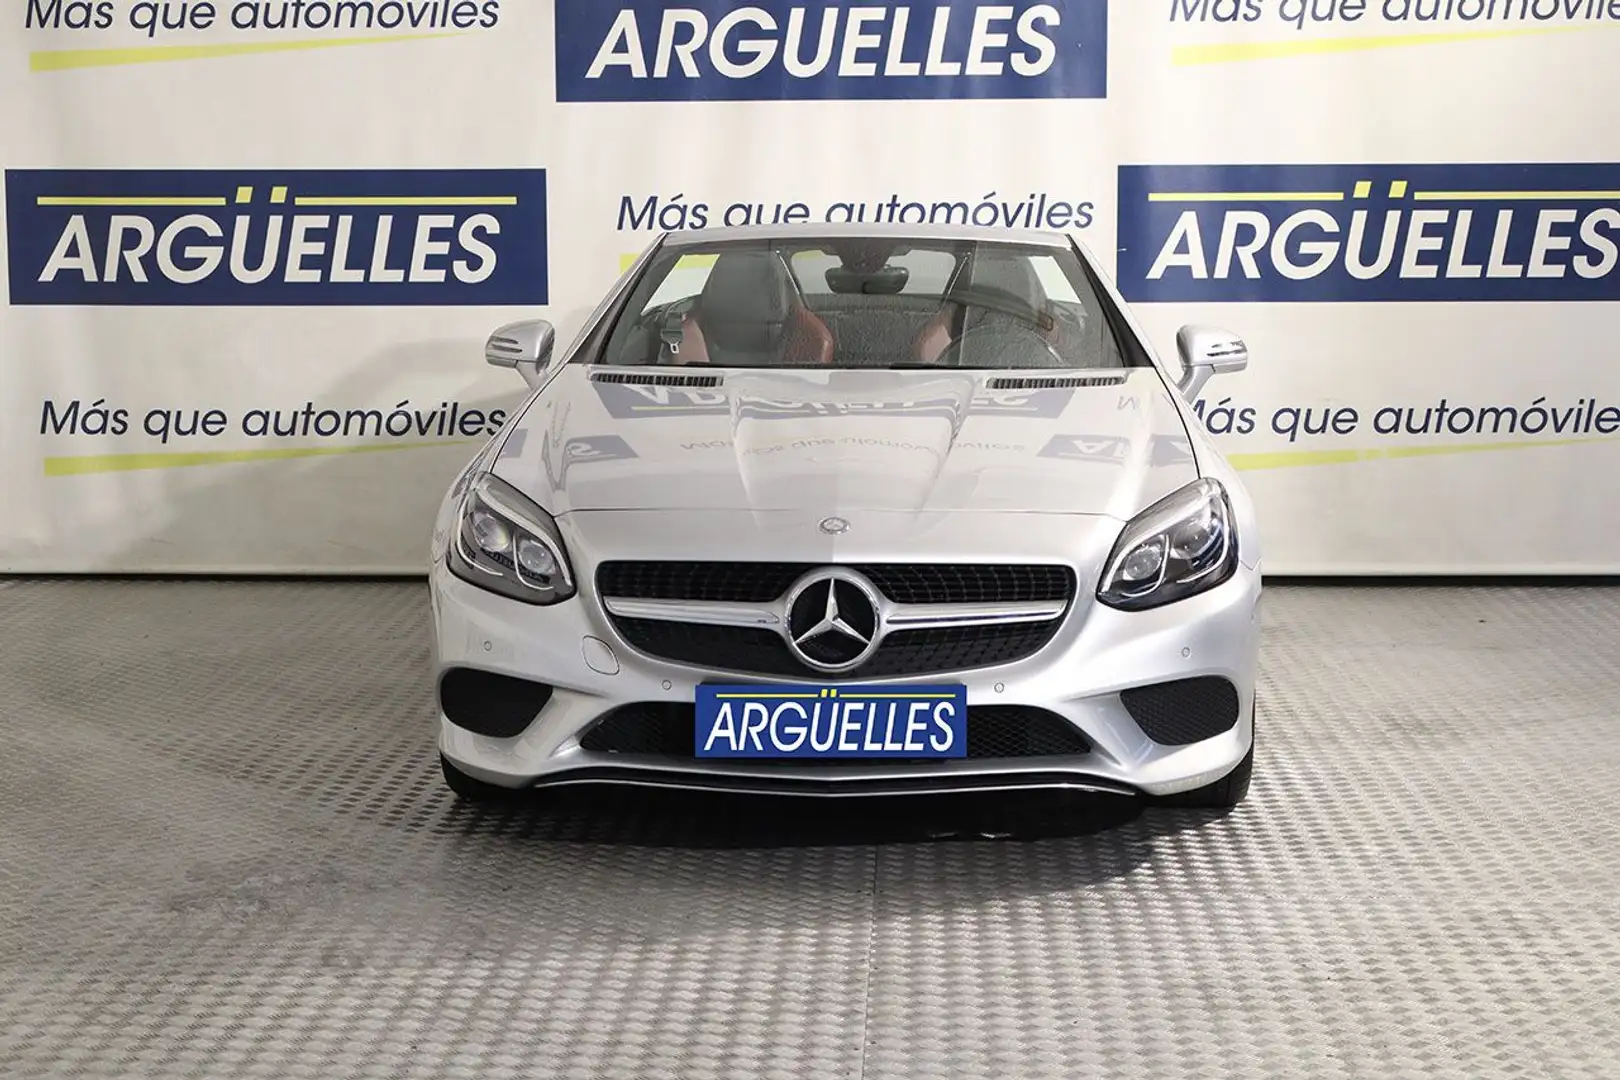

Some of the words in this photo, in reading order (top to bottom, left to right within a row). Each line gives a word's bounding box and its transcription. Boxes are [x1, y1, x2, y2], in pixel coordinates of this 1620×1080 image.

[129, 1, 216, 37] que
[1278, 0, 1366, 30] que
[617, 193, 708, 231] Más
[825, 191, 1095, 228] automóviles
[1146, 181, 1620, 280] ARGÜELLES
[37, 186, 500, 284] ARGÜELLES
[40, 399, 128, 435] Más
[143, 408, 227, 443] que
[241, 399, 506, 436] automóviles
[1271, 407, 1359, 442] que
[703, 689, 956, 752] ARGÜELLES
